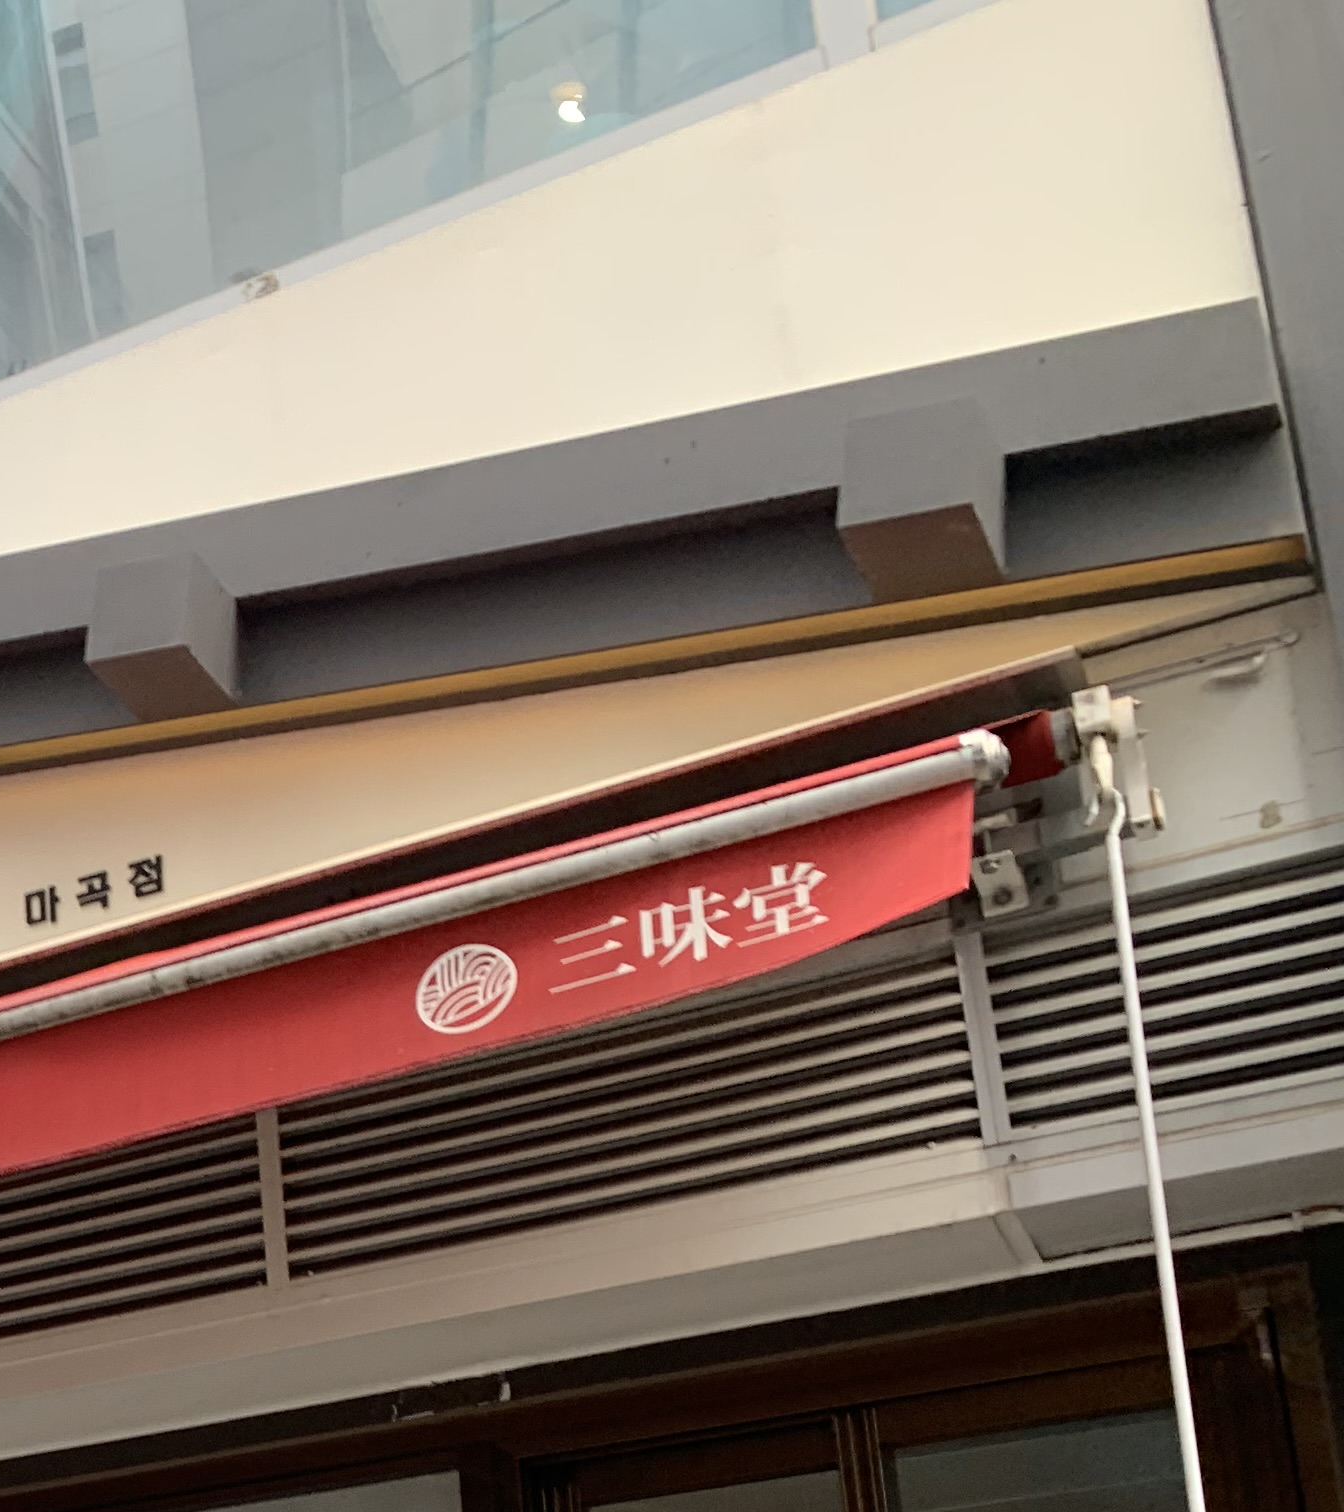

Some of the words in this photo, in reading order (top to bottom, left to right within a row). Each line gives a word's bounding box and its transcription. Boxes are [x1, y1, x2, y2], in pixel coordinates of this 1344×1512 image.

[24, 855, 167, 927] 마곡점
[549, 861, 829, 996] 三味堂
